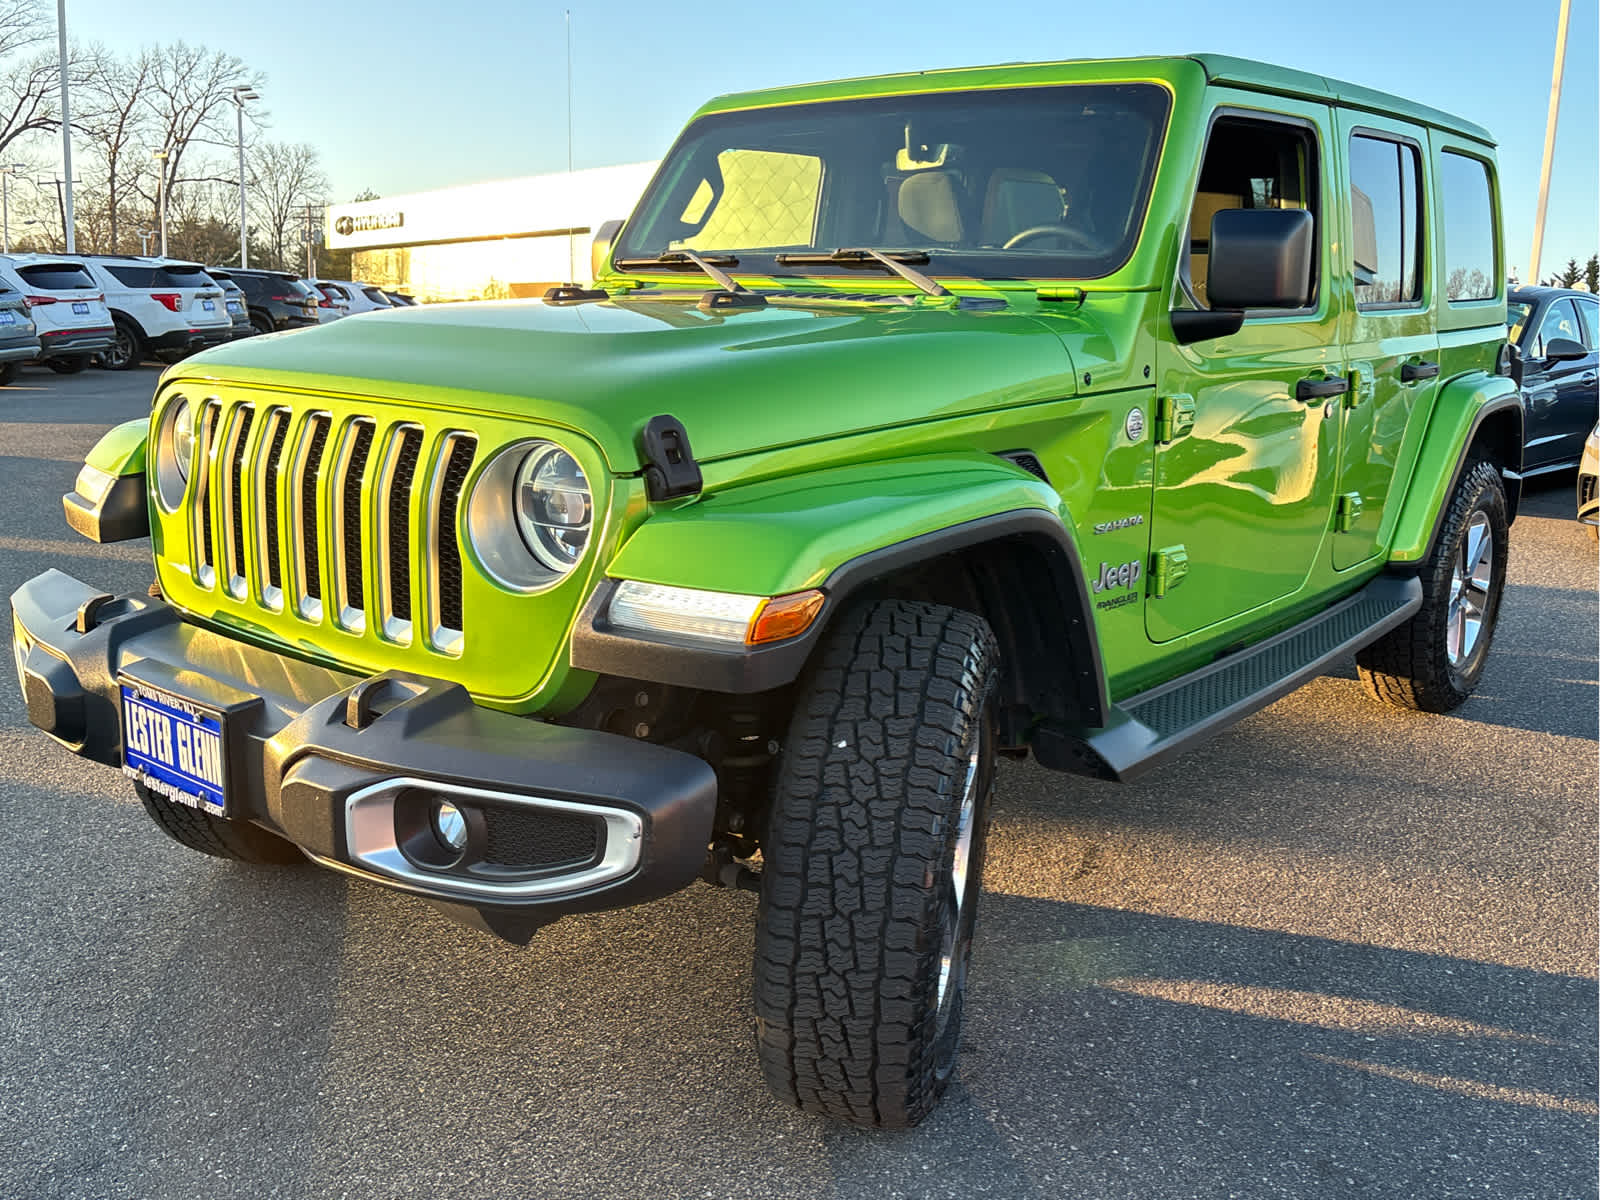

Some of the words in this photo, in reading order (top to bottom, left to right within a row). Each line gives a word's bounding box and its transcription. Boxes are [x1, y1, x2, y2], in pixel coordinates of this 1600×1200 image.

[1094, 515, 1144, 535] SAHARA
[1092, 560, 1141, 593] Jeep
[124, 700, 174, 767] LESTER
[176, 721, 223, 788] GLENN
